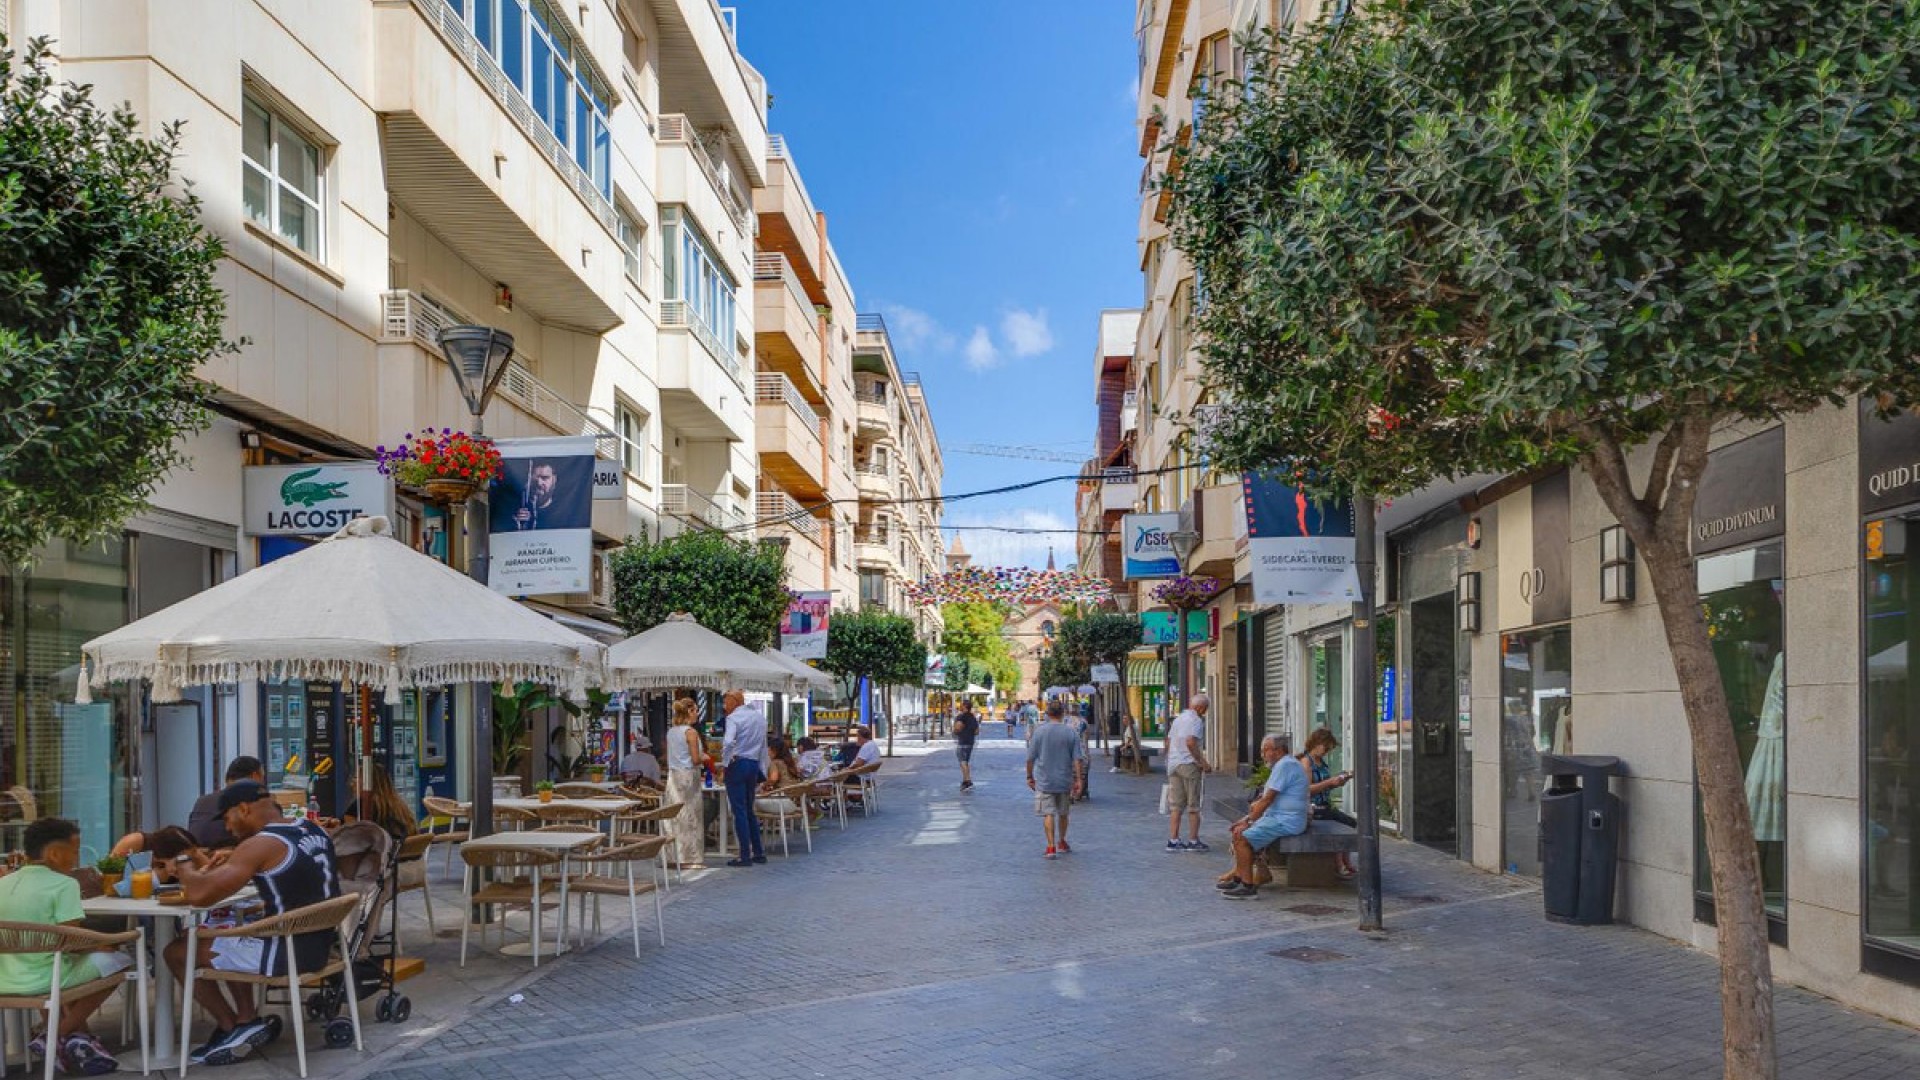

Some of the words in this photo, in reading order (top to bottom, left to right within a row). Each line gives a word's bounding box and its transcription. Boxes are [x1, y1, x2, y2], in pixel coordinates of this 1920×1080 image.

[593, 472, 618, 486] ARIA
[1869, 466, 1910, 497] QUID
[1698, 518, 1725, 541] QUID
[1726, 504, 1776, 532] DIVINUM
[1519, 567, 1544, 605] QD
